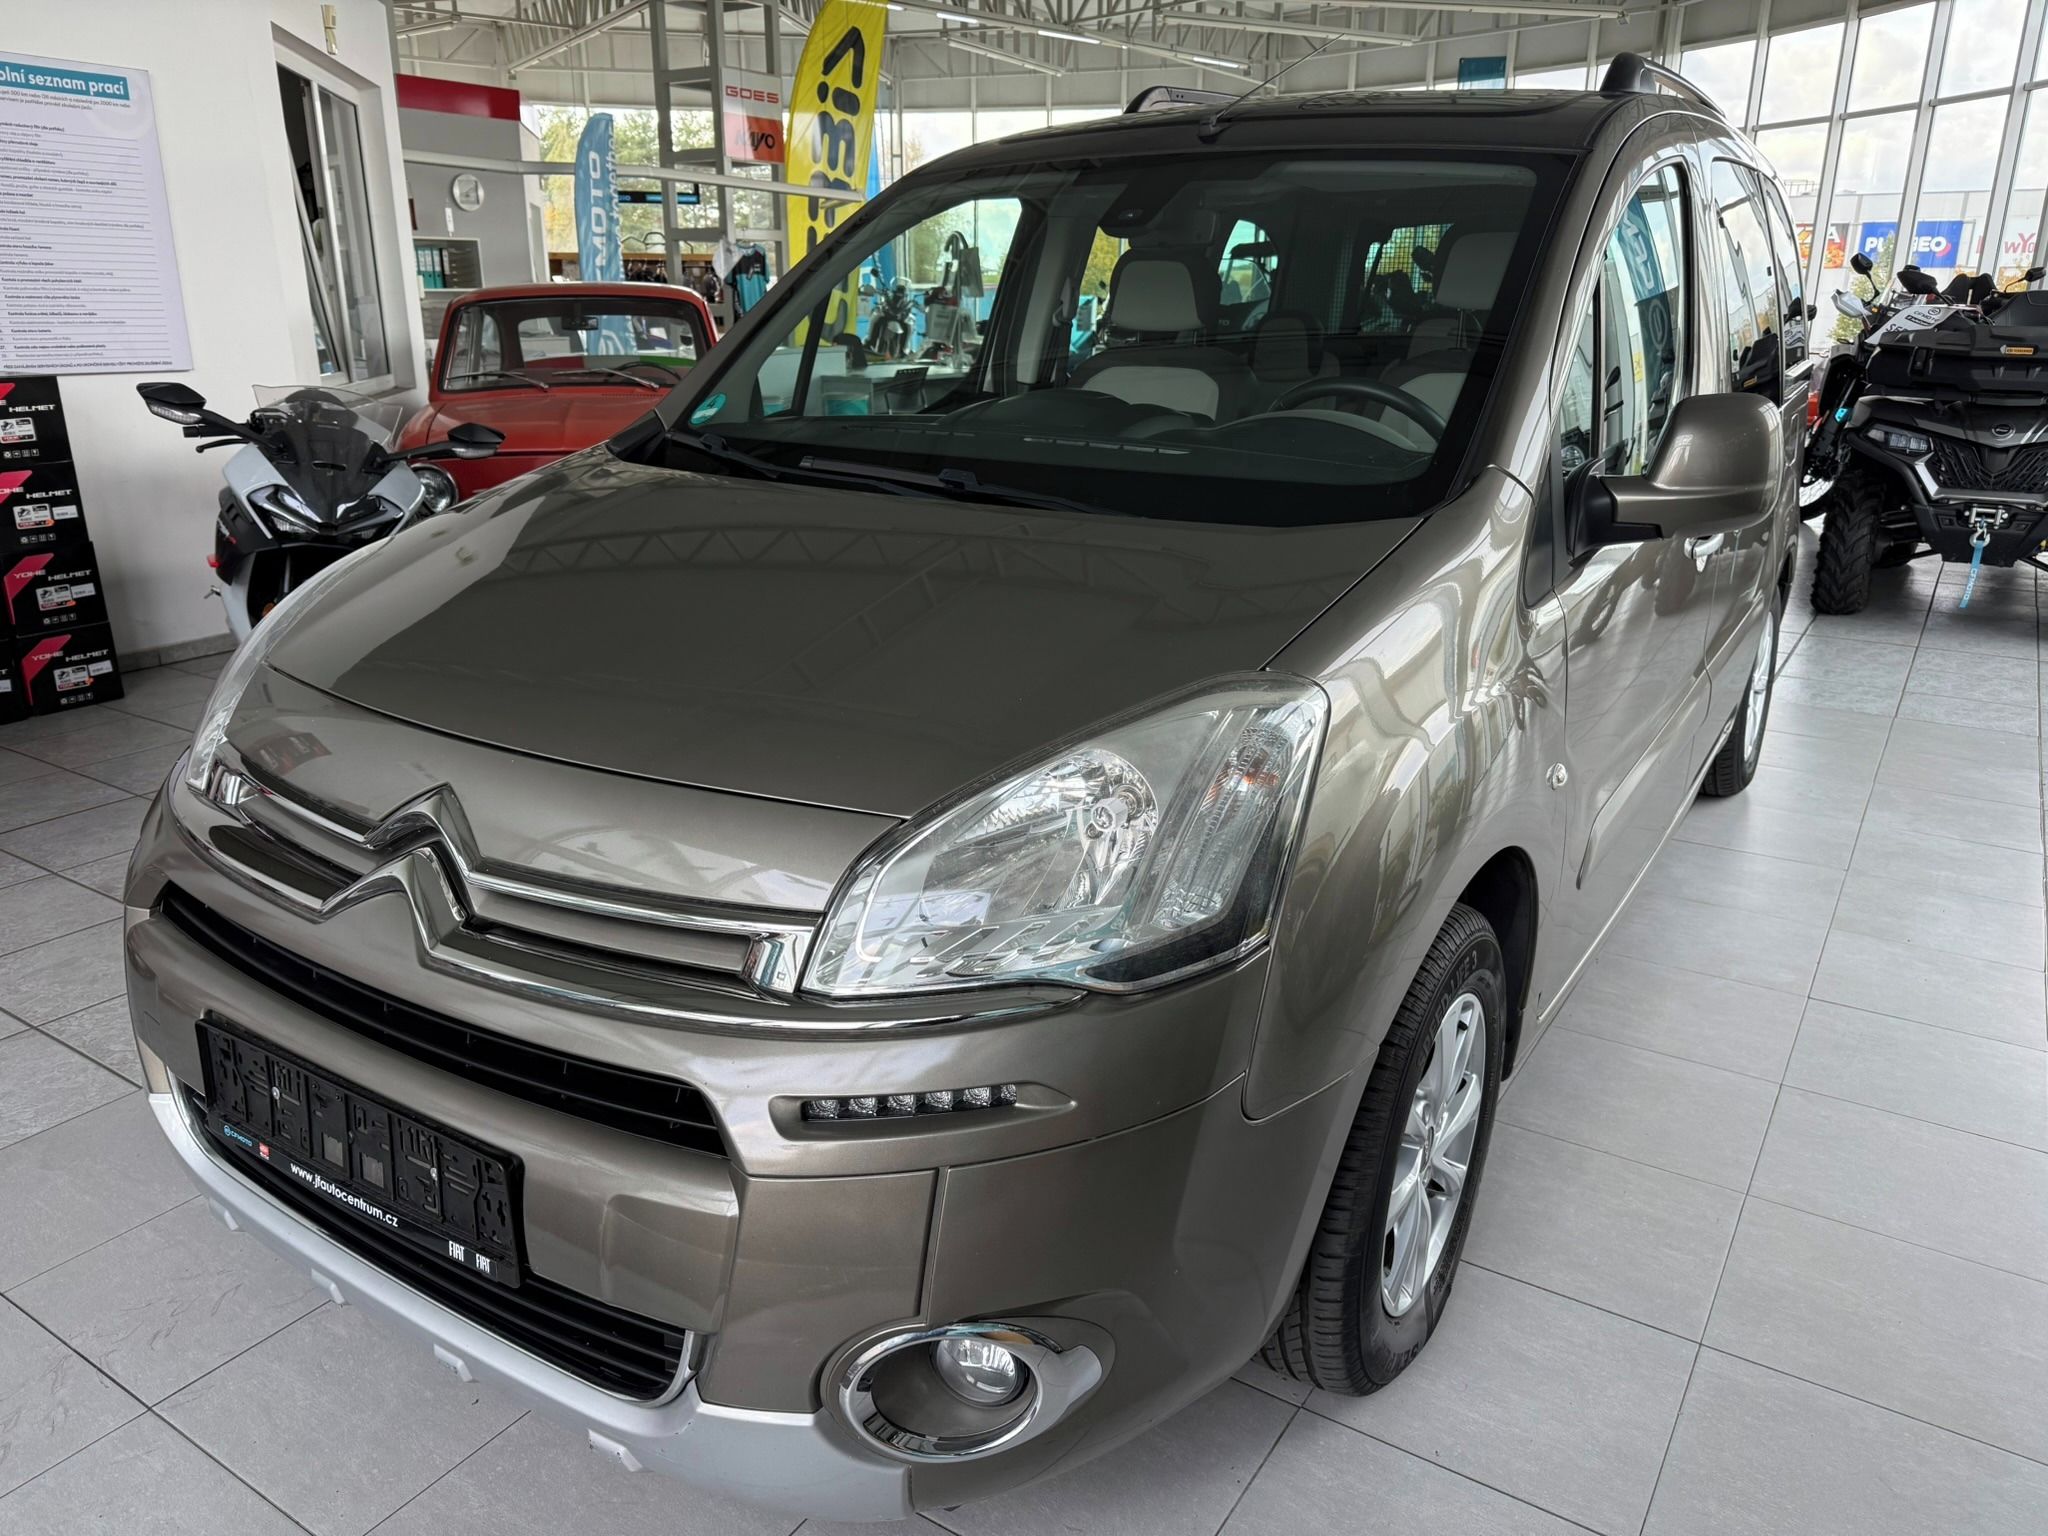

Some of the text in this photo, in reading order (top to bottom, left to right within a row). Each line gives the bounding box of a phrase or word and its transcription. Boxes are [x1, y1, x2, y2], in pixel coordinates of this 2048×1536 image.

[28, 73, 86, 92] seznam
[725, 85, 779, 104] GOES
[589, 151, 607, 280] MOTO
[9, 404, 56, 413] HELMET
[26, 489, 72, 499] HELMET
[14, 569, 92, 581] YOHE HELMET
[32, 649, 109, 662] YOHE HELMET
[290, 1163, 399, 1228] www.jfautocentrum.cz
[448, 1240, 491, 1274] FIAT FIAT
